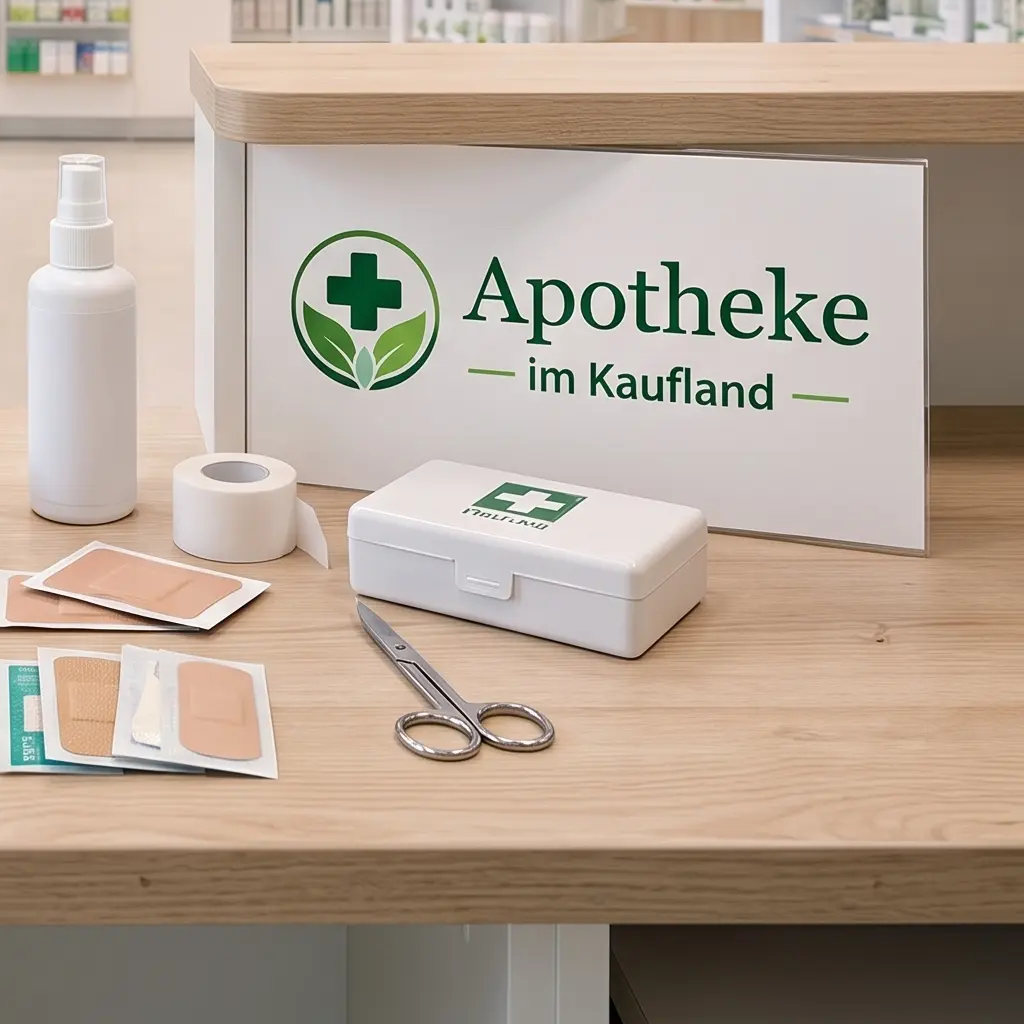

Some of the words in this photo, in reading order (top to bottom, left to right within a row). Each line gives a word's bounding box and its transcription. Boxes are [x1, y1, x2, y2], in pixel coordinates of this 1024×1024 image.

[463, 256, 870, 347] Apotheke
[529, 356, 575, 395] im
[589, 362, 774, 411] Kaufland
